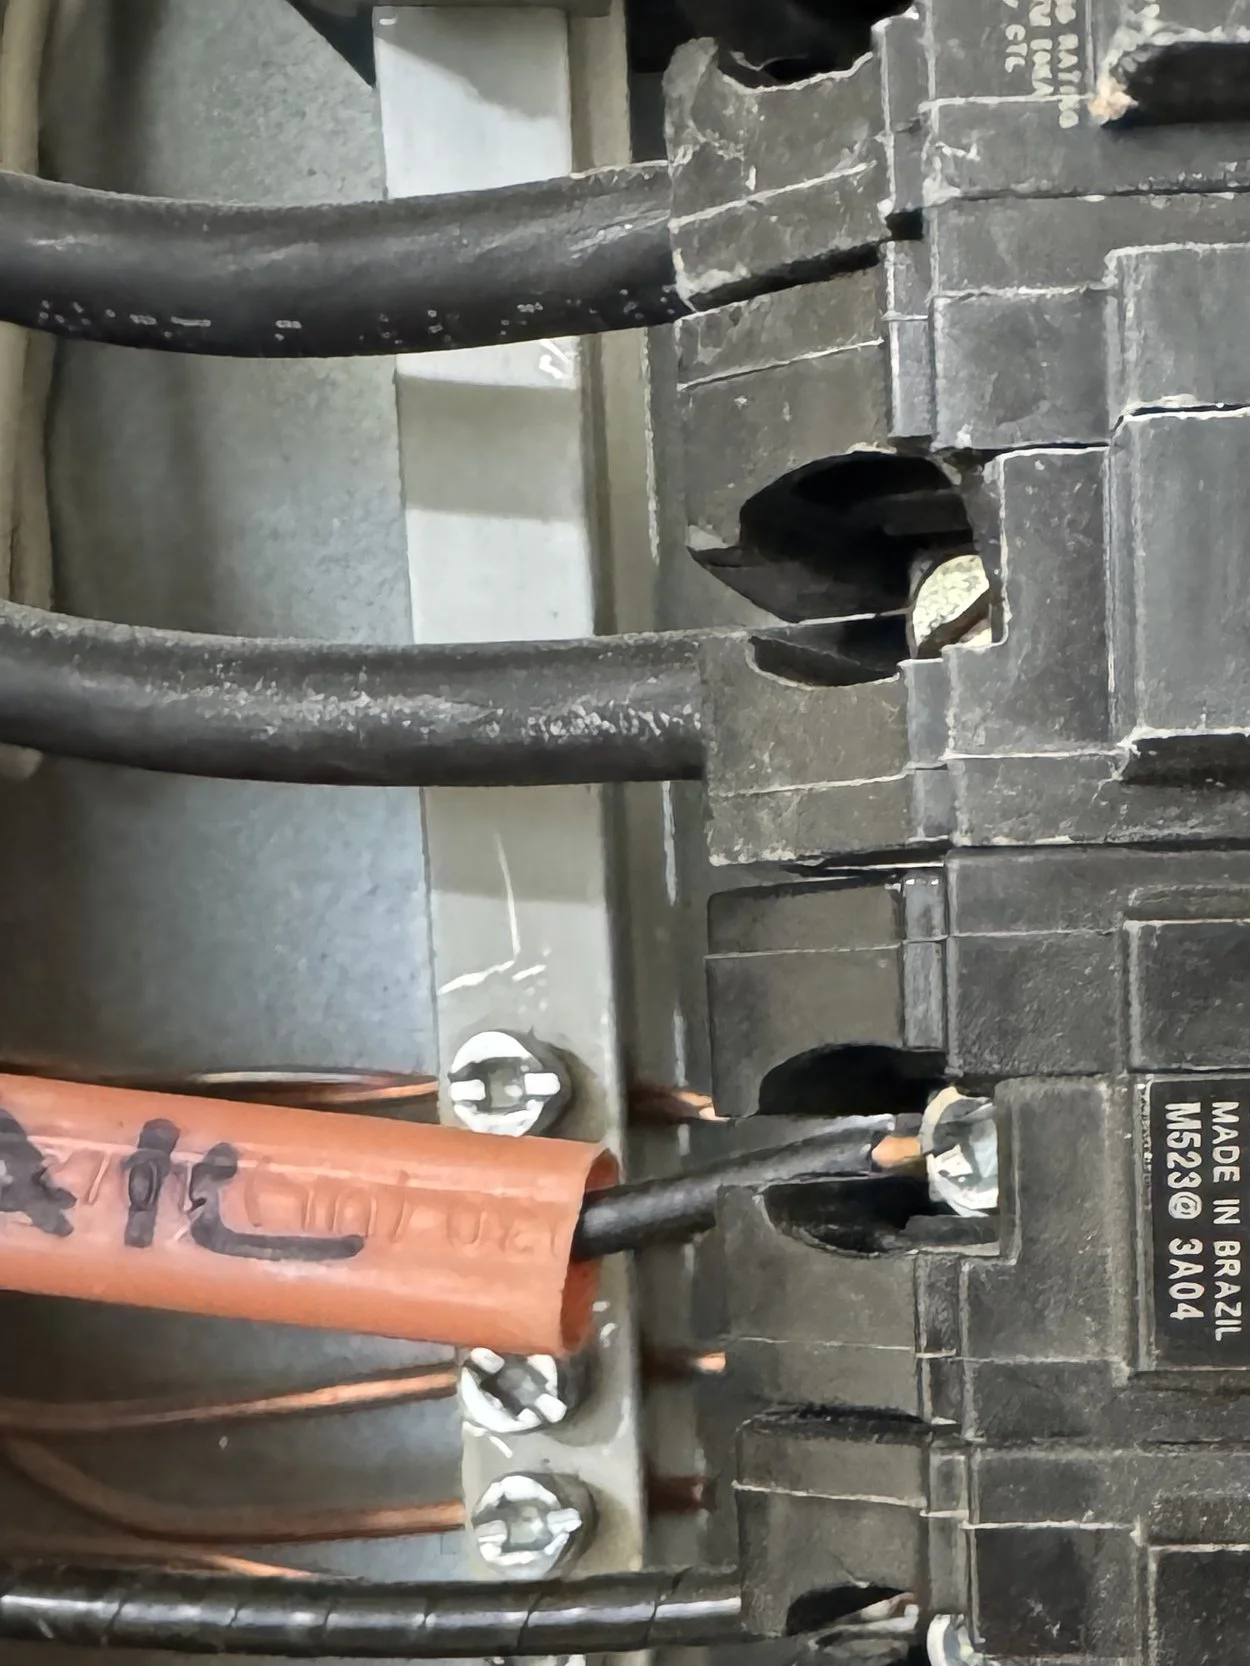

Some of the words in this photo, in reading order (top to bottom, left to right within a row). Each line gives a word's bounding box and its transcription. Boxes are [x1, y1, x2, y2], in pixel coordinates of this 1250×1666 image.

[1211, 1101, 1240, 1183] MADE
[1213, 1199, 1241, 1225] IN
[1168, 1237, 1204, 1320] 3A04
[1213, 1240, 1242, 1341] BRAZIL
